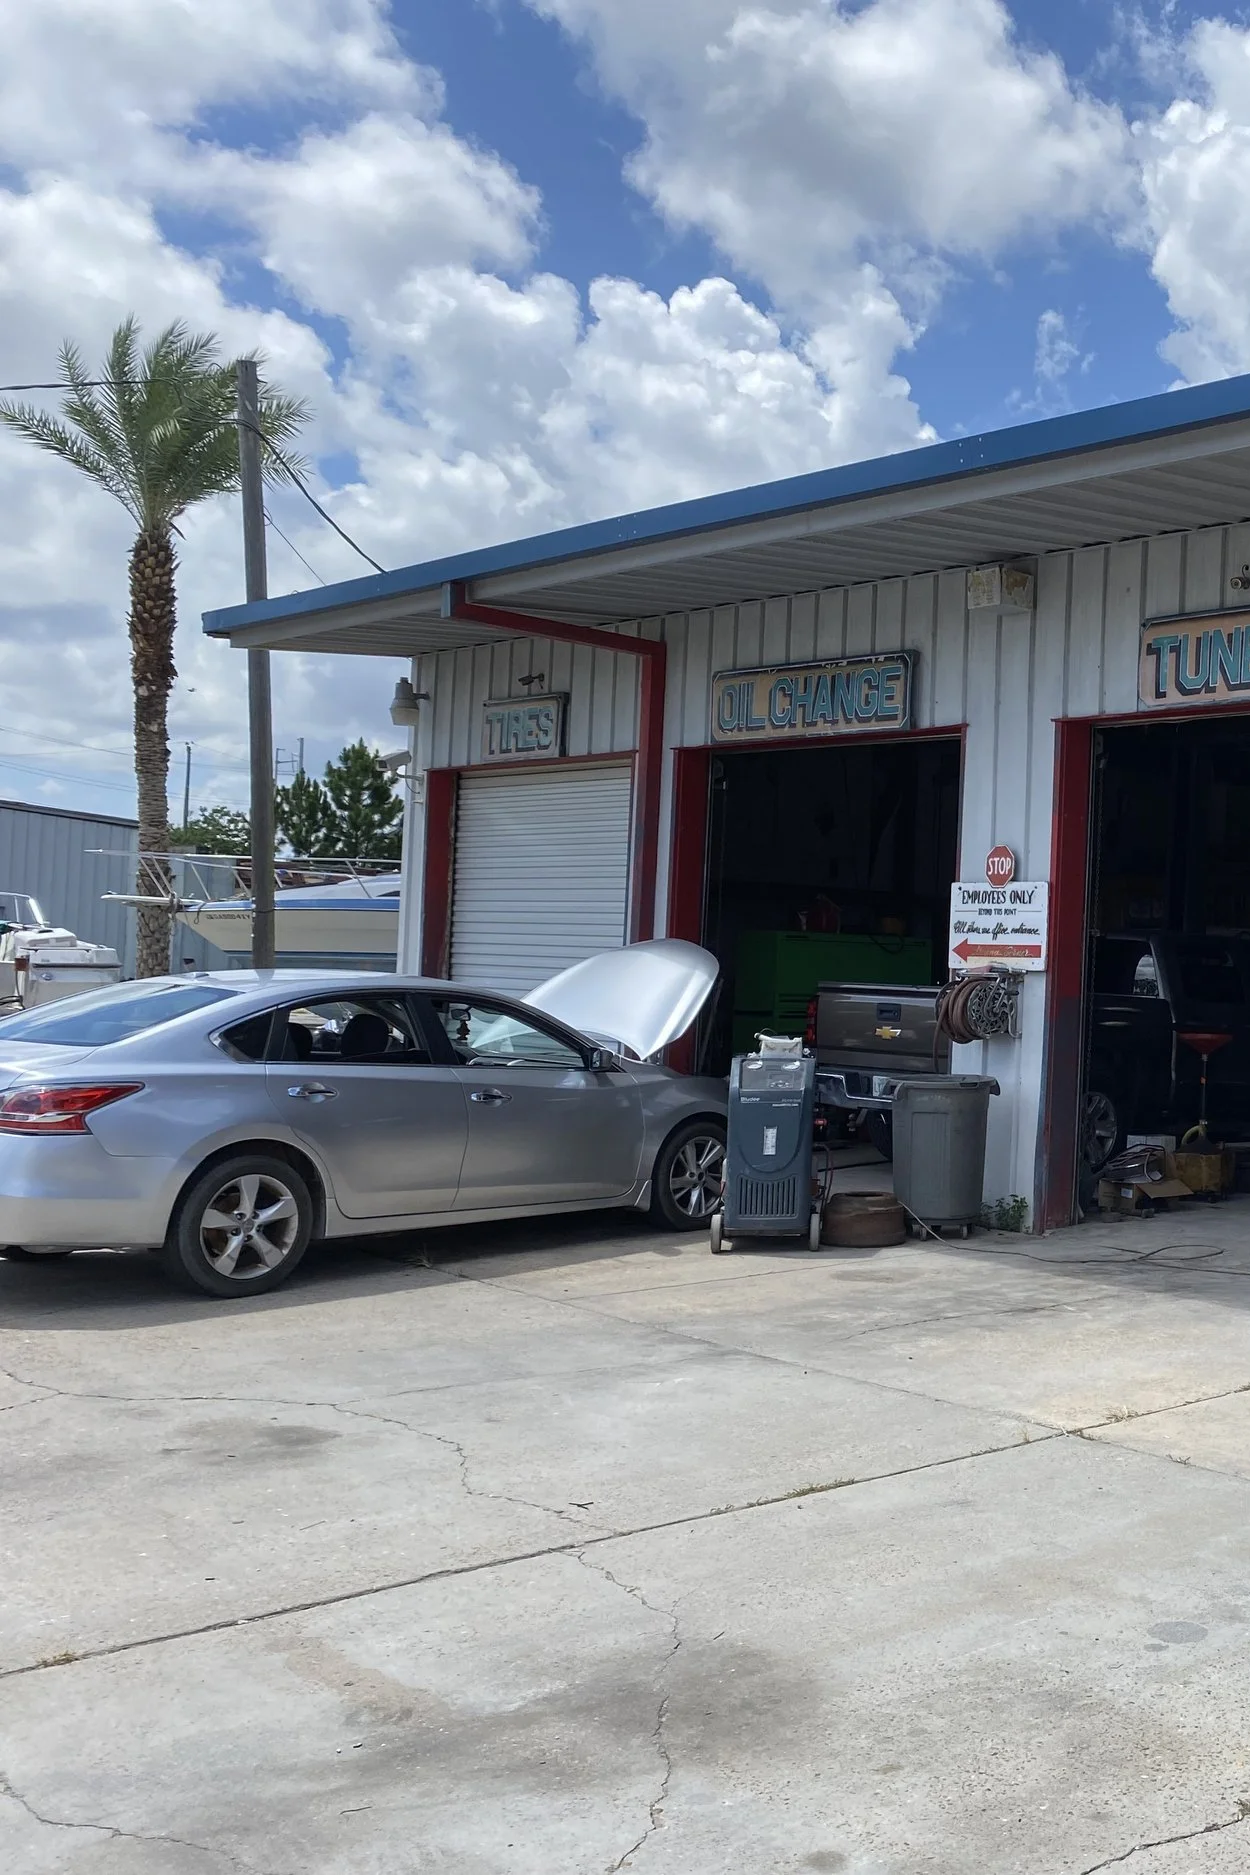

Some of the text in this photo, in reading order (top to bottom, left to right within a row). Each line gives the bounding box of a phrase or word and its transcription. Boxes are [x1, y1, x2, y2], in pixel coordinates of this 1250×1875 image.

[718, 664, 904, 730] OIL CHANGE
[486, 705, 554, 755] TIRES
[987, 857, 1012, 876] STOP
[962, 890, 1035, 905] EMPLOYEES ONLY
